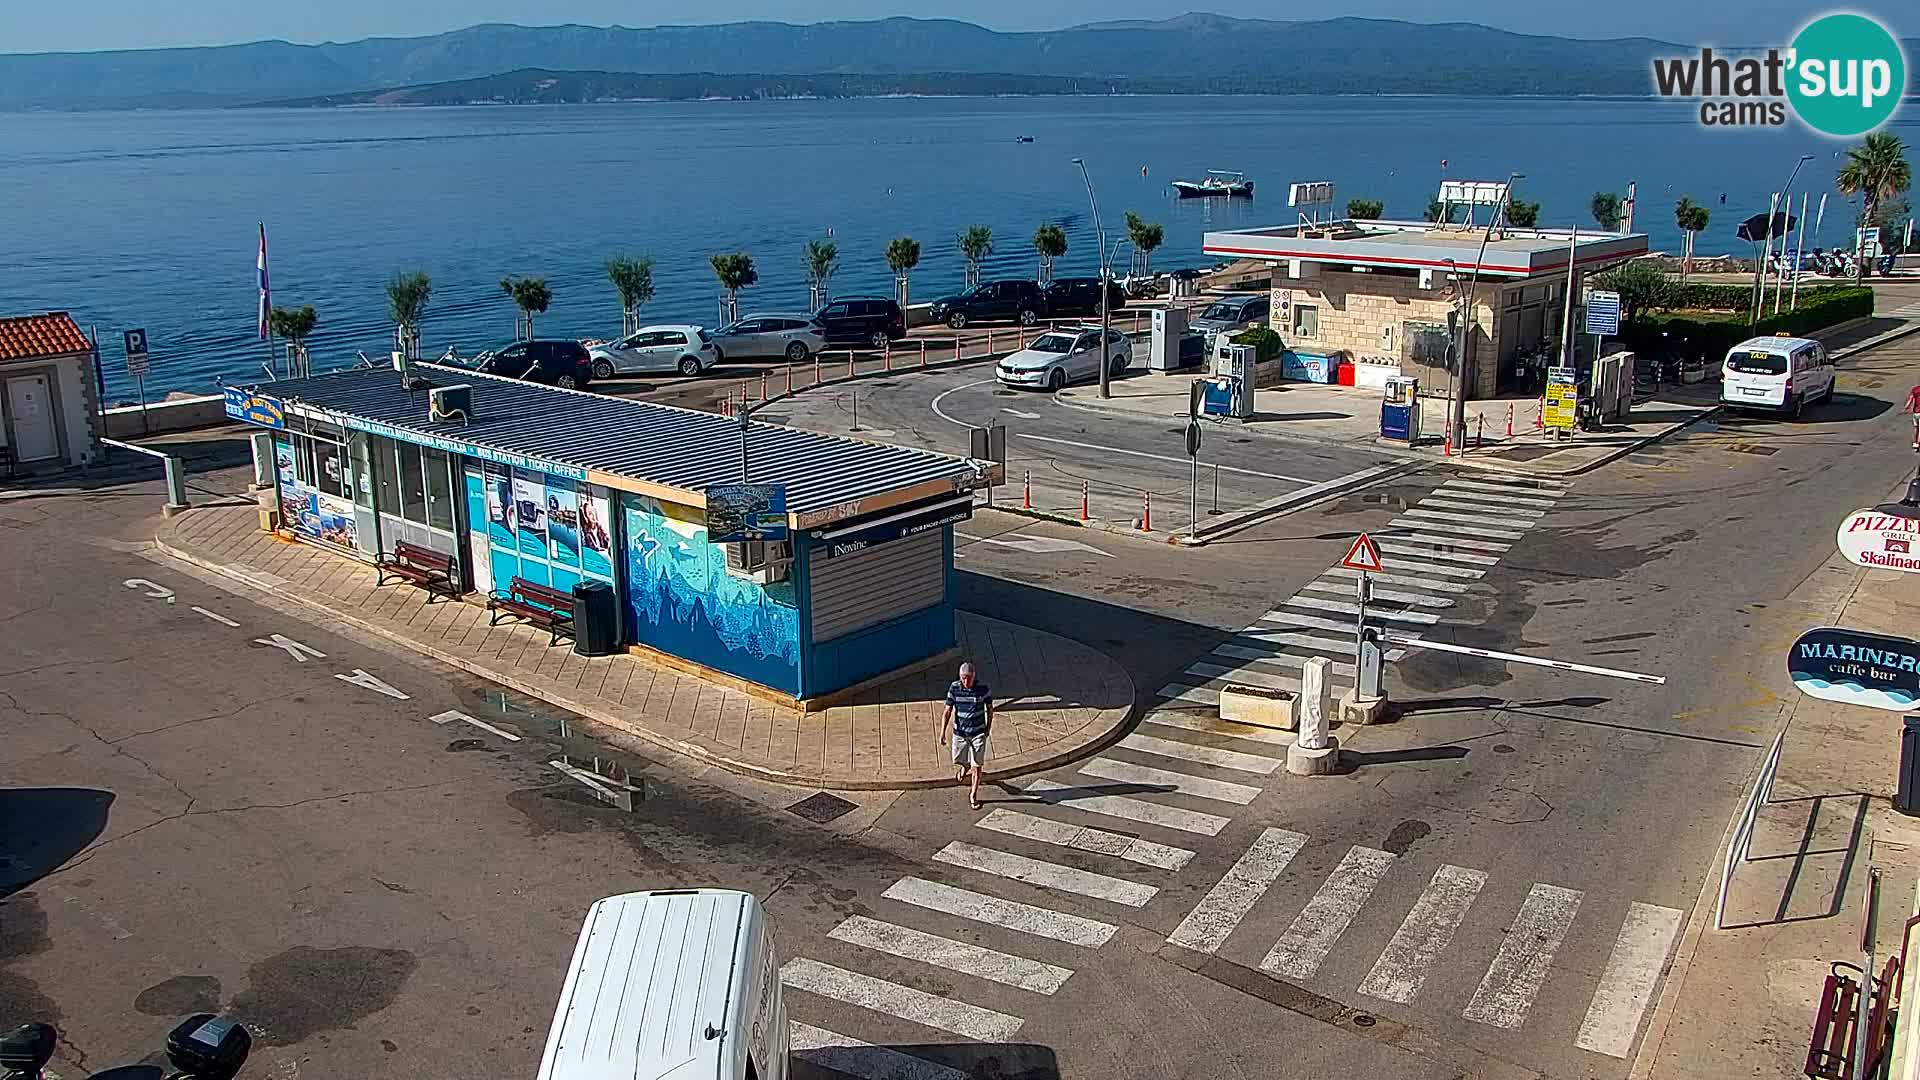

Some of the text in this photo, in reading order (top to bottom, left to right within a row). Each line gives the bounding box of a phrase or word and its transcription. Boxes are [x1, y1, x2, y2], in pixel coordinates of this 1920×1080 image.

[128, 332, 142, 351] P
[1751, 352, 1768, 360] TAXI
[435, 438, 467, 453] POSTAJA
[477, 447, 492, 459] BUS
[492, 451, 526, 467] STATION
[527, 458, 554, 473] TICKET
[554, 464, 582, 479] OFFICE
[1881, 531, 1917, 542] GRILL
[1829, 663, 1897, 681] caffe bar
